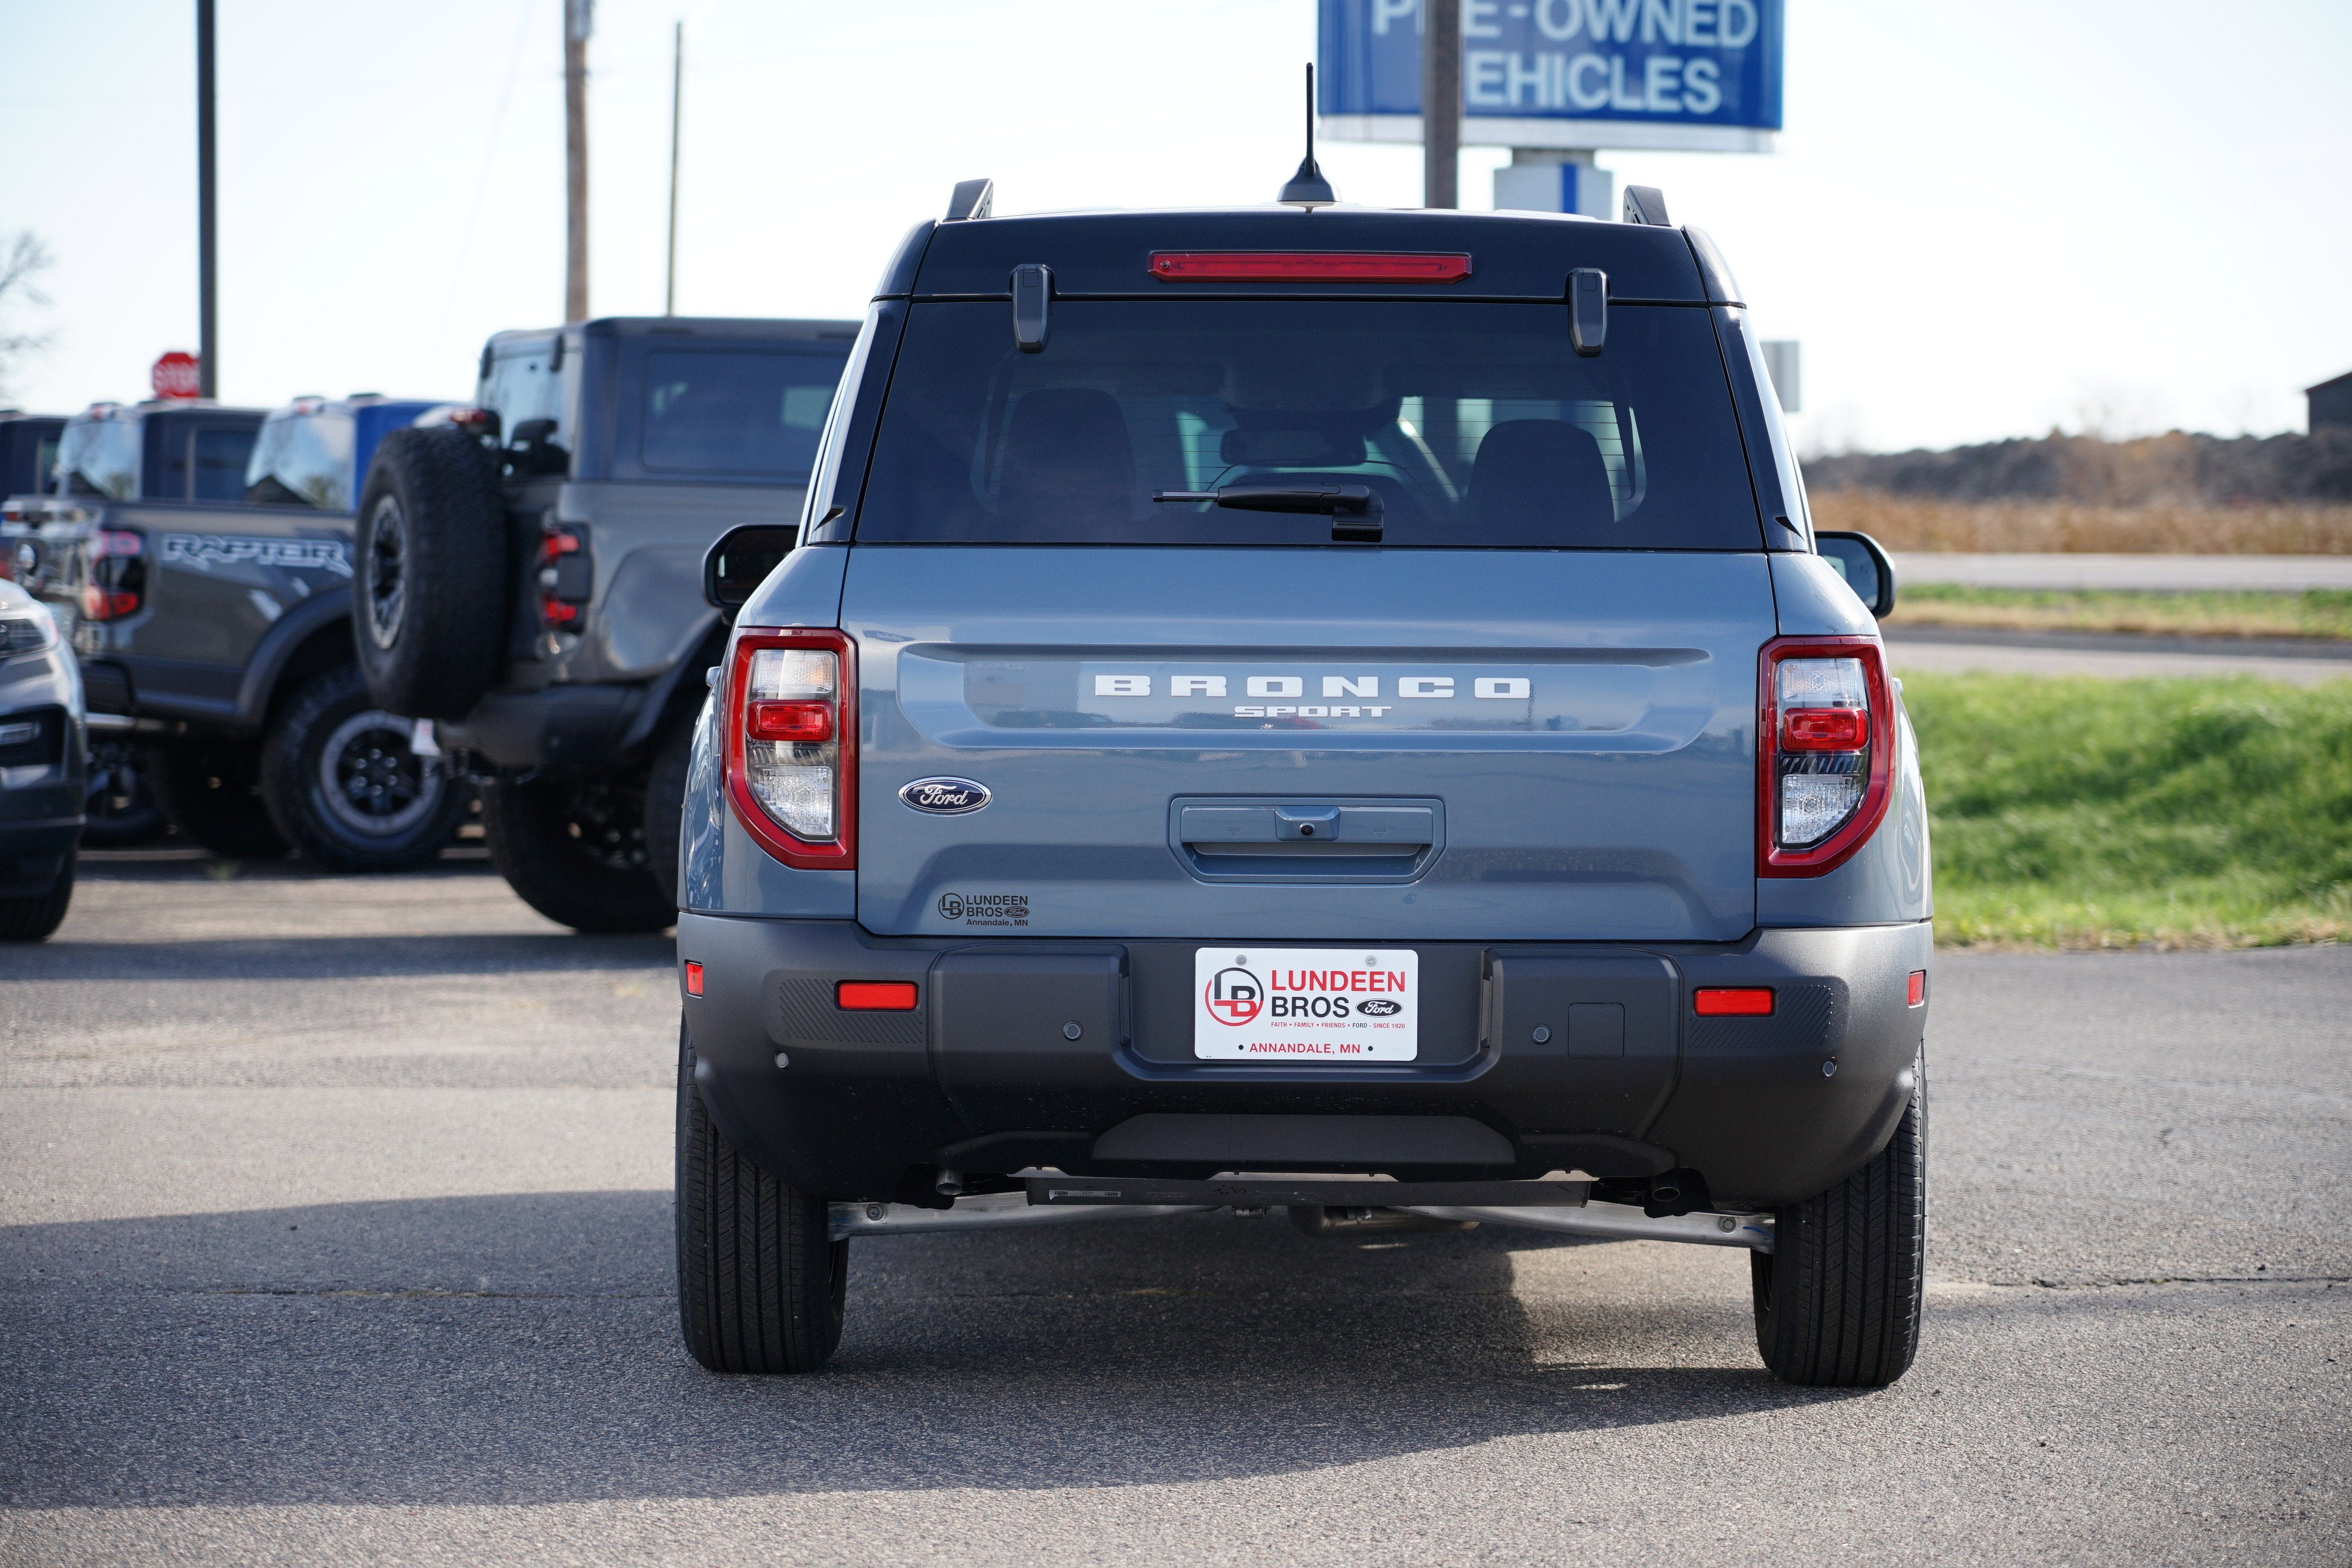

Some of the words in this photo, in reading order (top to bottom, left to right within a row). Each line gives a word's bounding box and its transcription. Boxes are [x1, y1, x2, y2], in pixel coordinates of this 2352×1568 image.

[1373, 0, 1758, 48] PE-OWNED
[1466, 52, 1722, 114] EHICLES
[163, 533, 354, 578] RAPTOR
[1095, 675, 1530, 699] BRONCO
[1235, 706, 1392, 717] SPORT
[966, 895, 1028, 905] LUNDEEN
[966, 907, 1003, 917] BROS
[1272, 970, 1405, 992] LUNDEEN
[1272, 996, 1349, 1018] BROS
[1250, 1043, 1335, 1055] ANNANDALE,
[1340, 1044, 1361, 1054] MN
